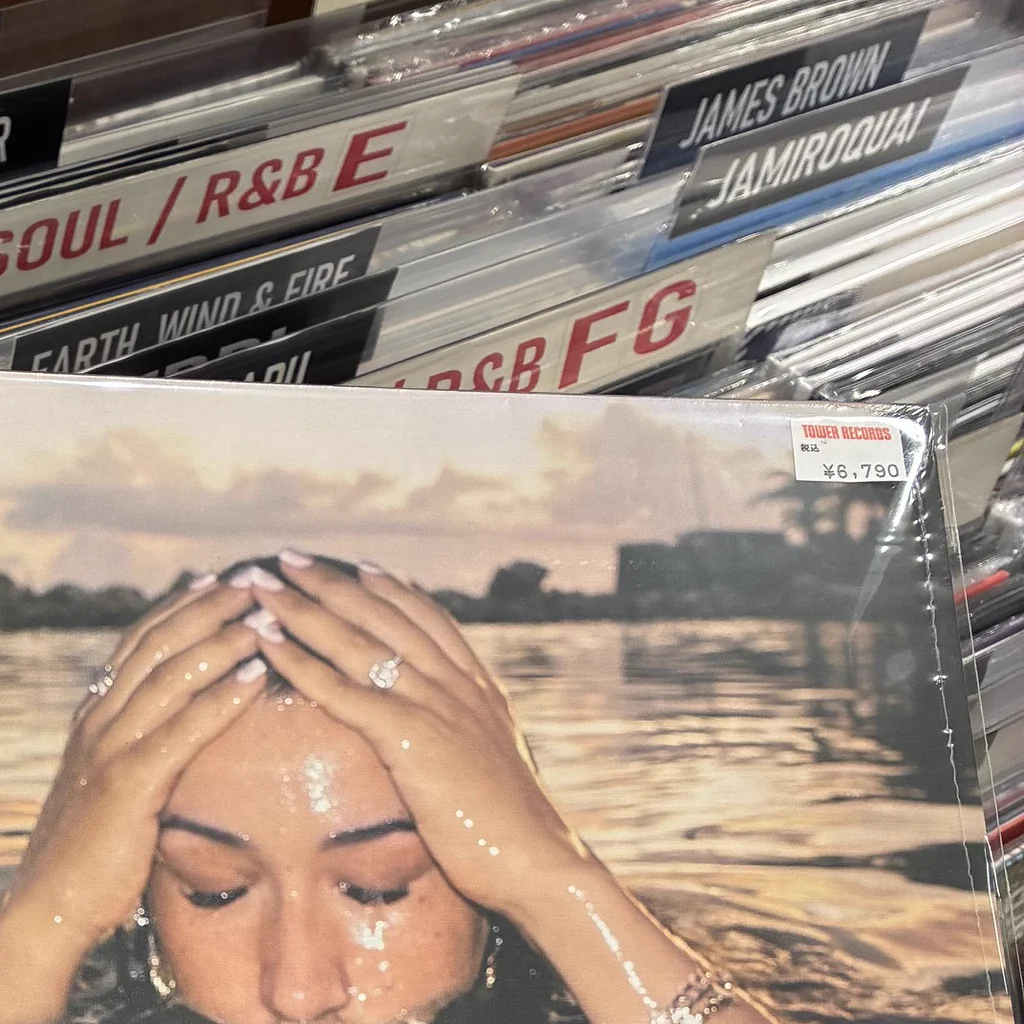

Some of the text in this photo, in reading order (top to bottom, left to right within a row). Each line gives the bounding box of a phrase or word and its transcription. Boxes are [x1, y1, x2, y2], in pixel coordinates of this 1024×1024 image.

[679, 40, 892, 149] JAMES BROWN
[147, 175, 186, 246] /
[195, 146, 326, 224] R&B
[331, 121, 407, 193] E
[706, 96, 932, 209] JAMIROQUAI
[30, 321, 141, 373] EARTH
[158, 291, 243, 344] WIND
[800, 443, 820, 453] 税込
[801, 424, 892, 441] TOWER RECORDS
[822, 463, 899, 479] ¥6,790
